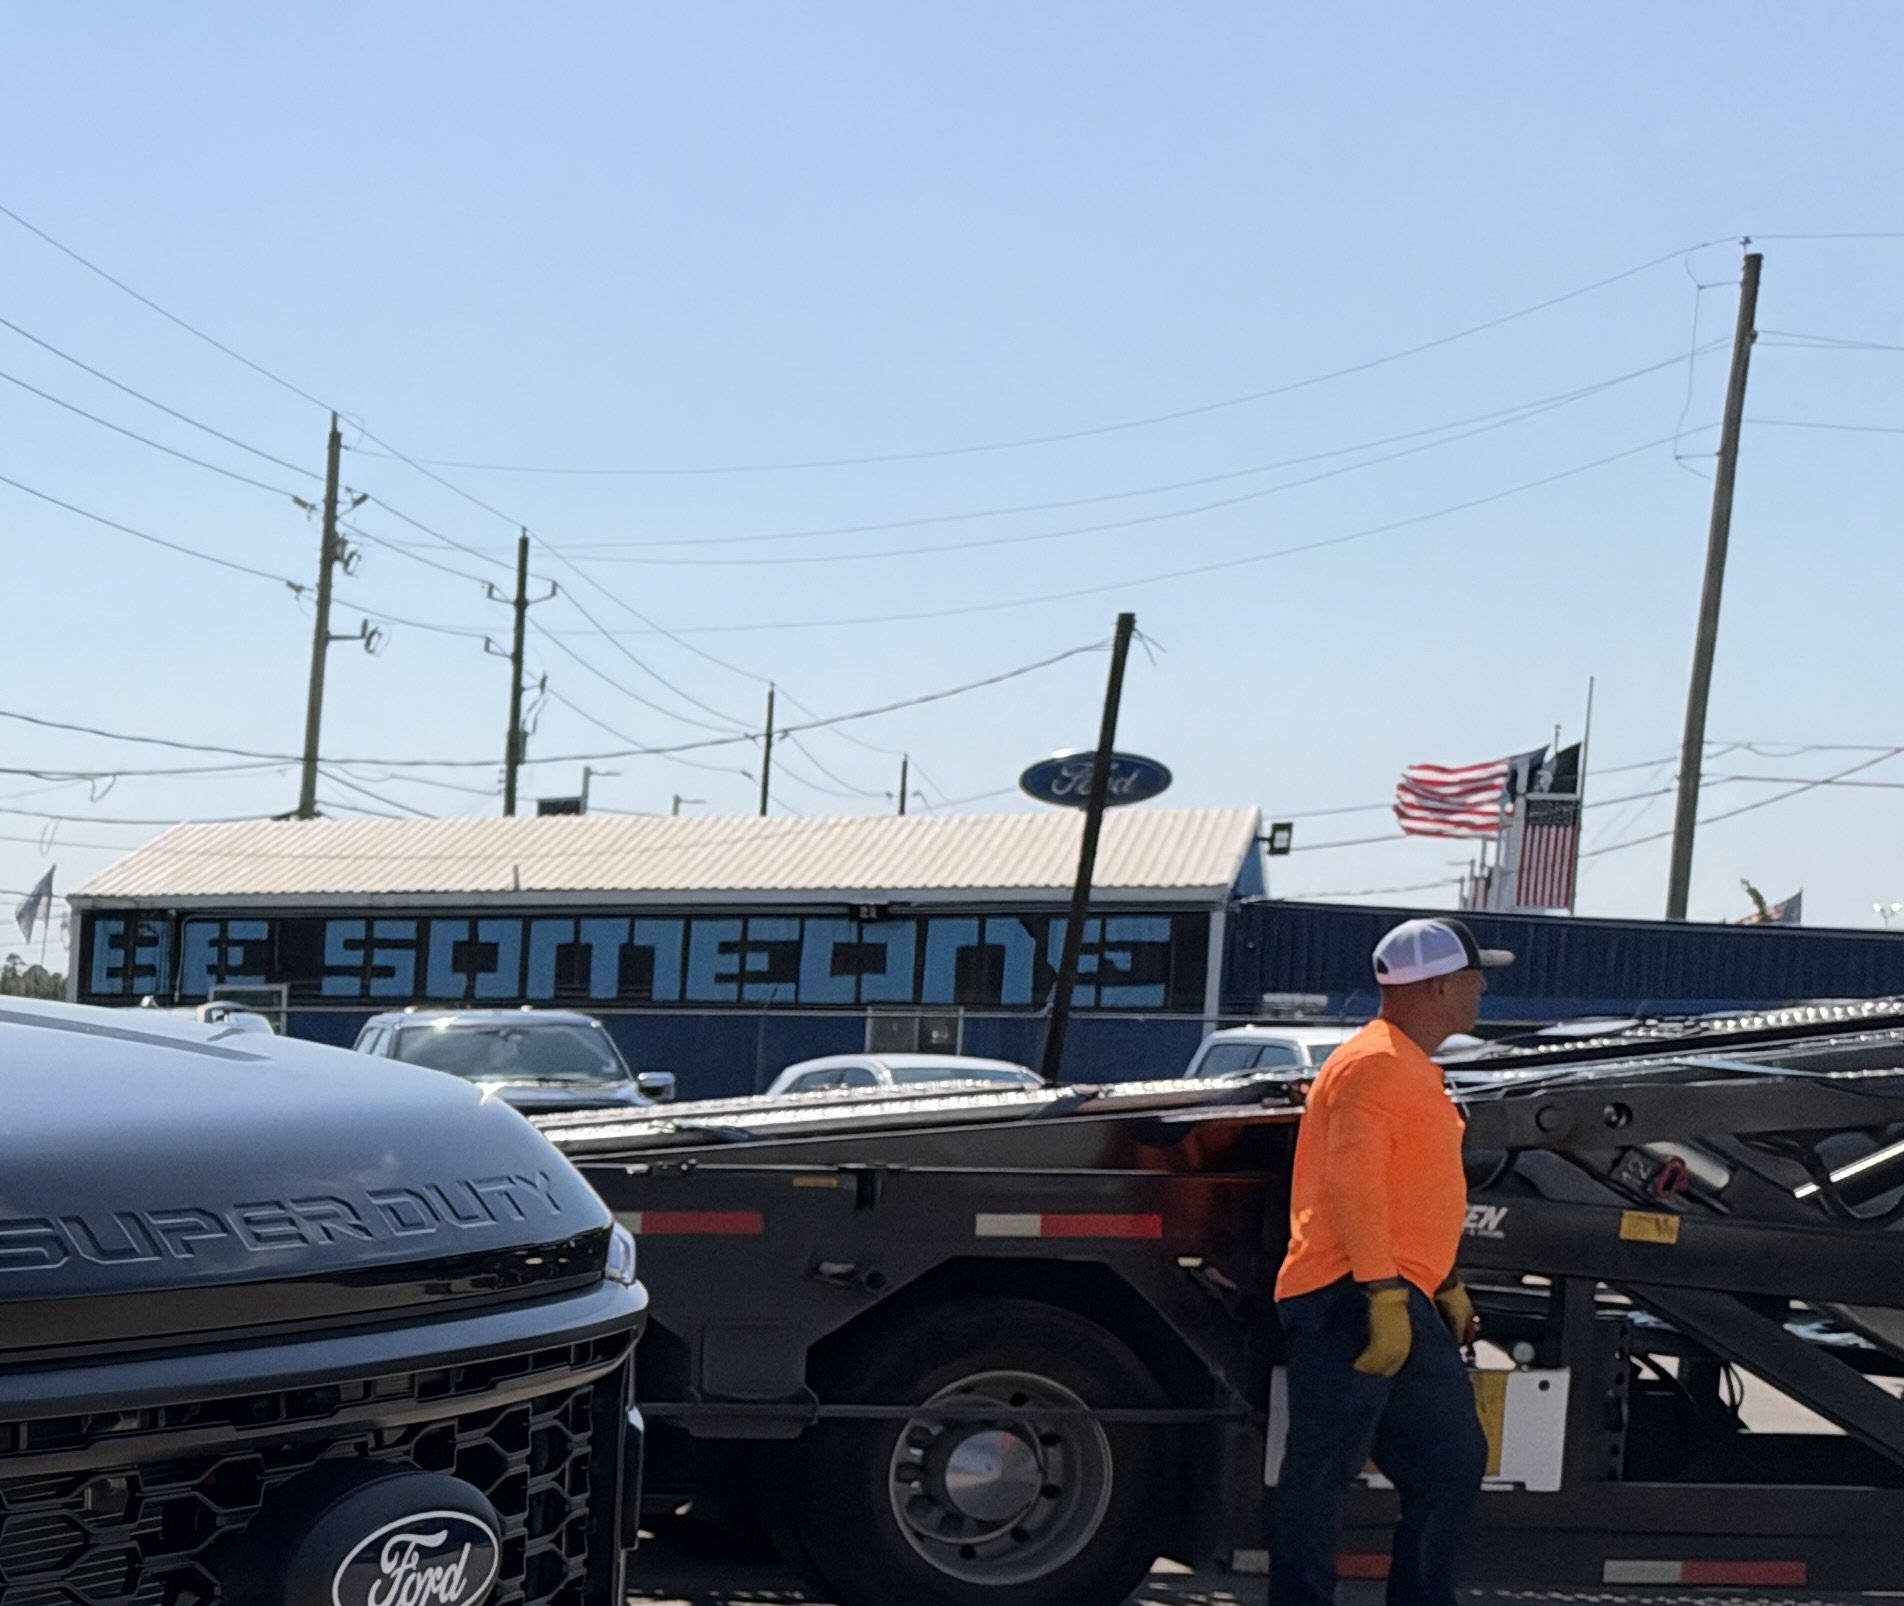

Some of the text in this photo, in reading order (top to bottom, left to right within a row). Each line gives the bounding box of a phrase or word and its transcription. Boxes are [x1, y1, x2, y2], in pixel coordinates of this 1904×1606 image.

[1050, 760, 1143, 796] Fod
[93, 917, 1174, 1009] BE SOMEONE
[367, 1169, 564, 1237] DUTY
